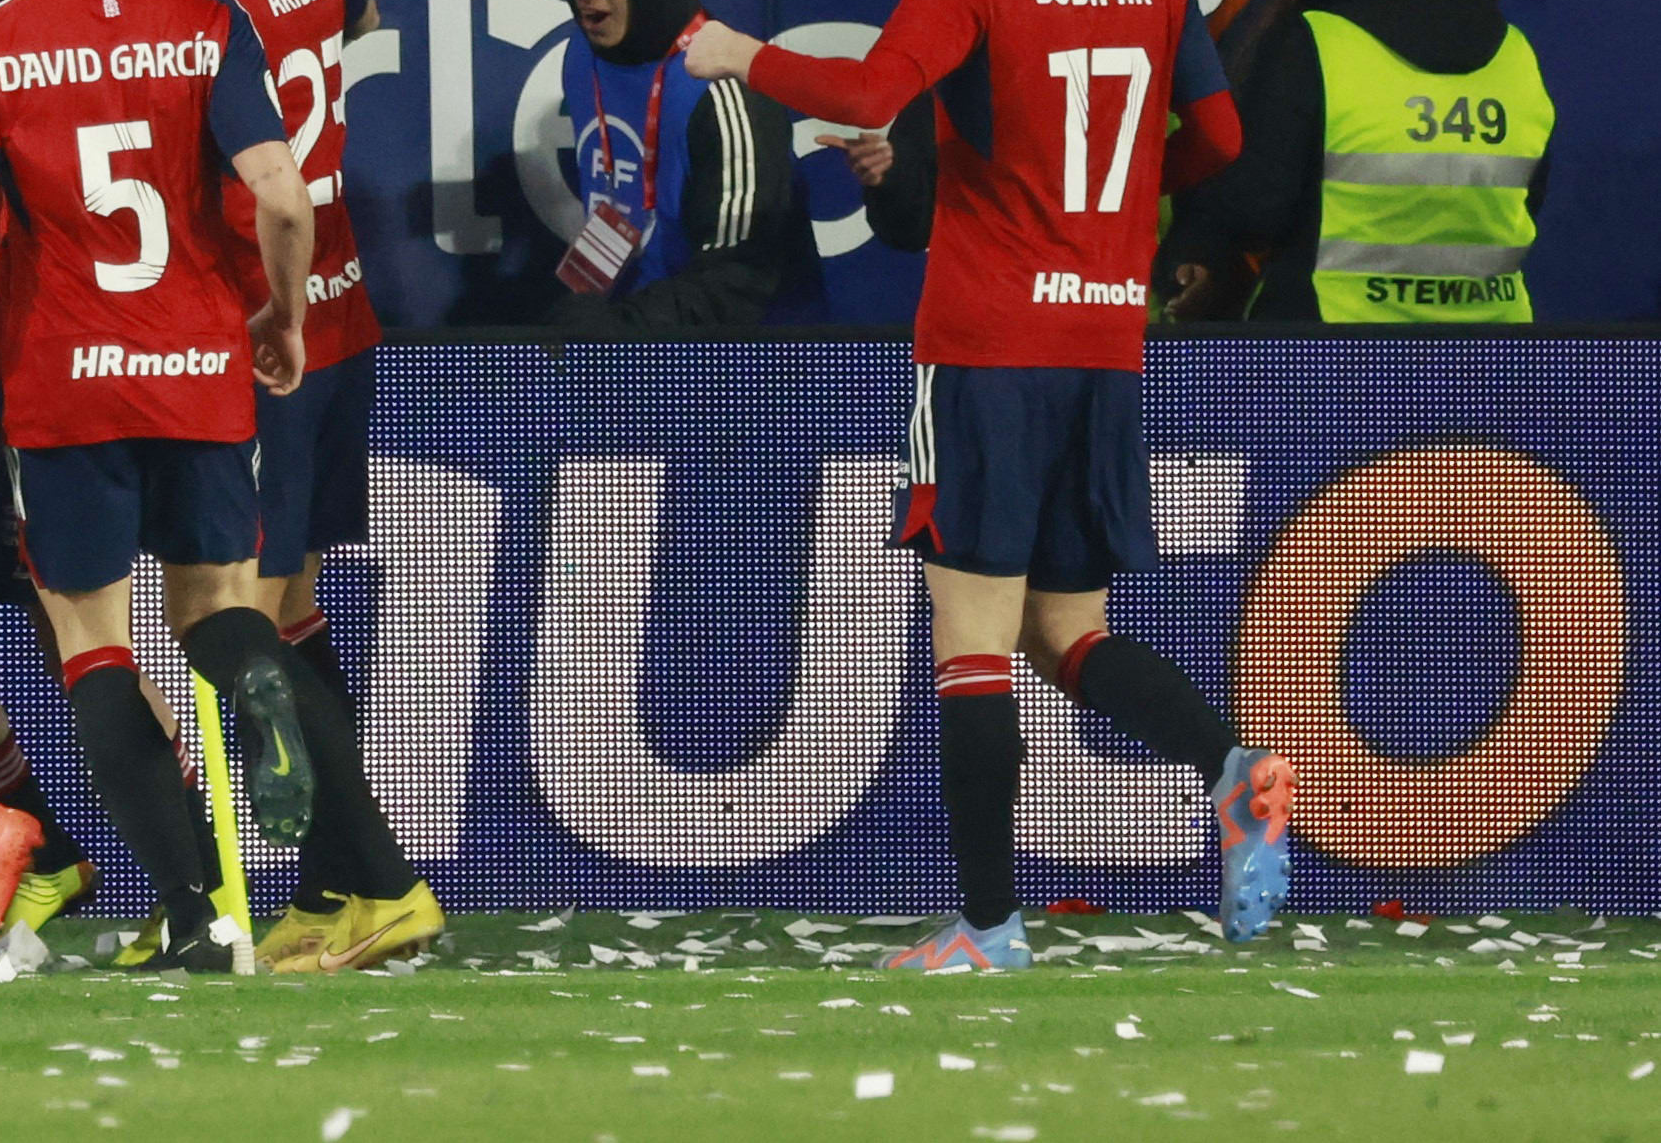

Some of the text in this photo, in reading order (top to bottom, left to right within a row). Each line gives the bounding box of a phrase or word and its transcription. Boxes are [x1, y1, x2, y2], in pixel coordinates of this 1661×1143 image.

[109, 31, 221, 81] GARCÍA
[1048, 46, 1152, 213] 17
[1404, 95, 1507, 145] 349
[76, 119, 172, 294] 5
[1366, 276, 1516, 305] STEWARD
